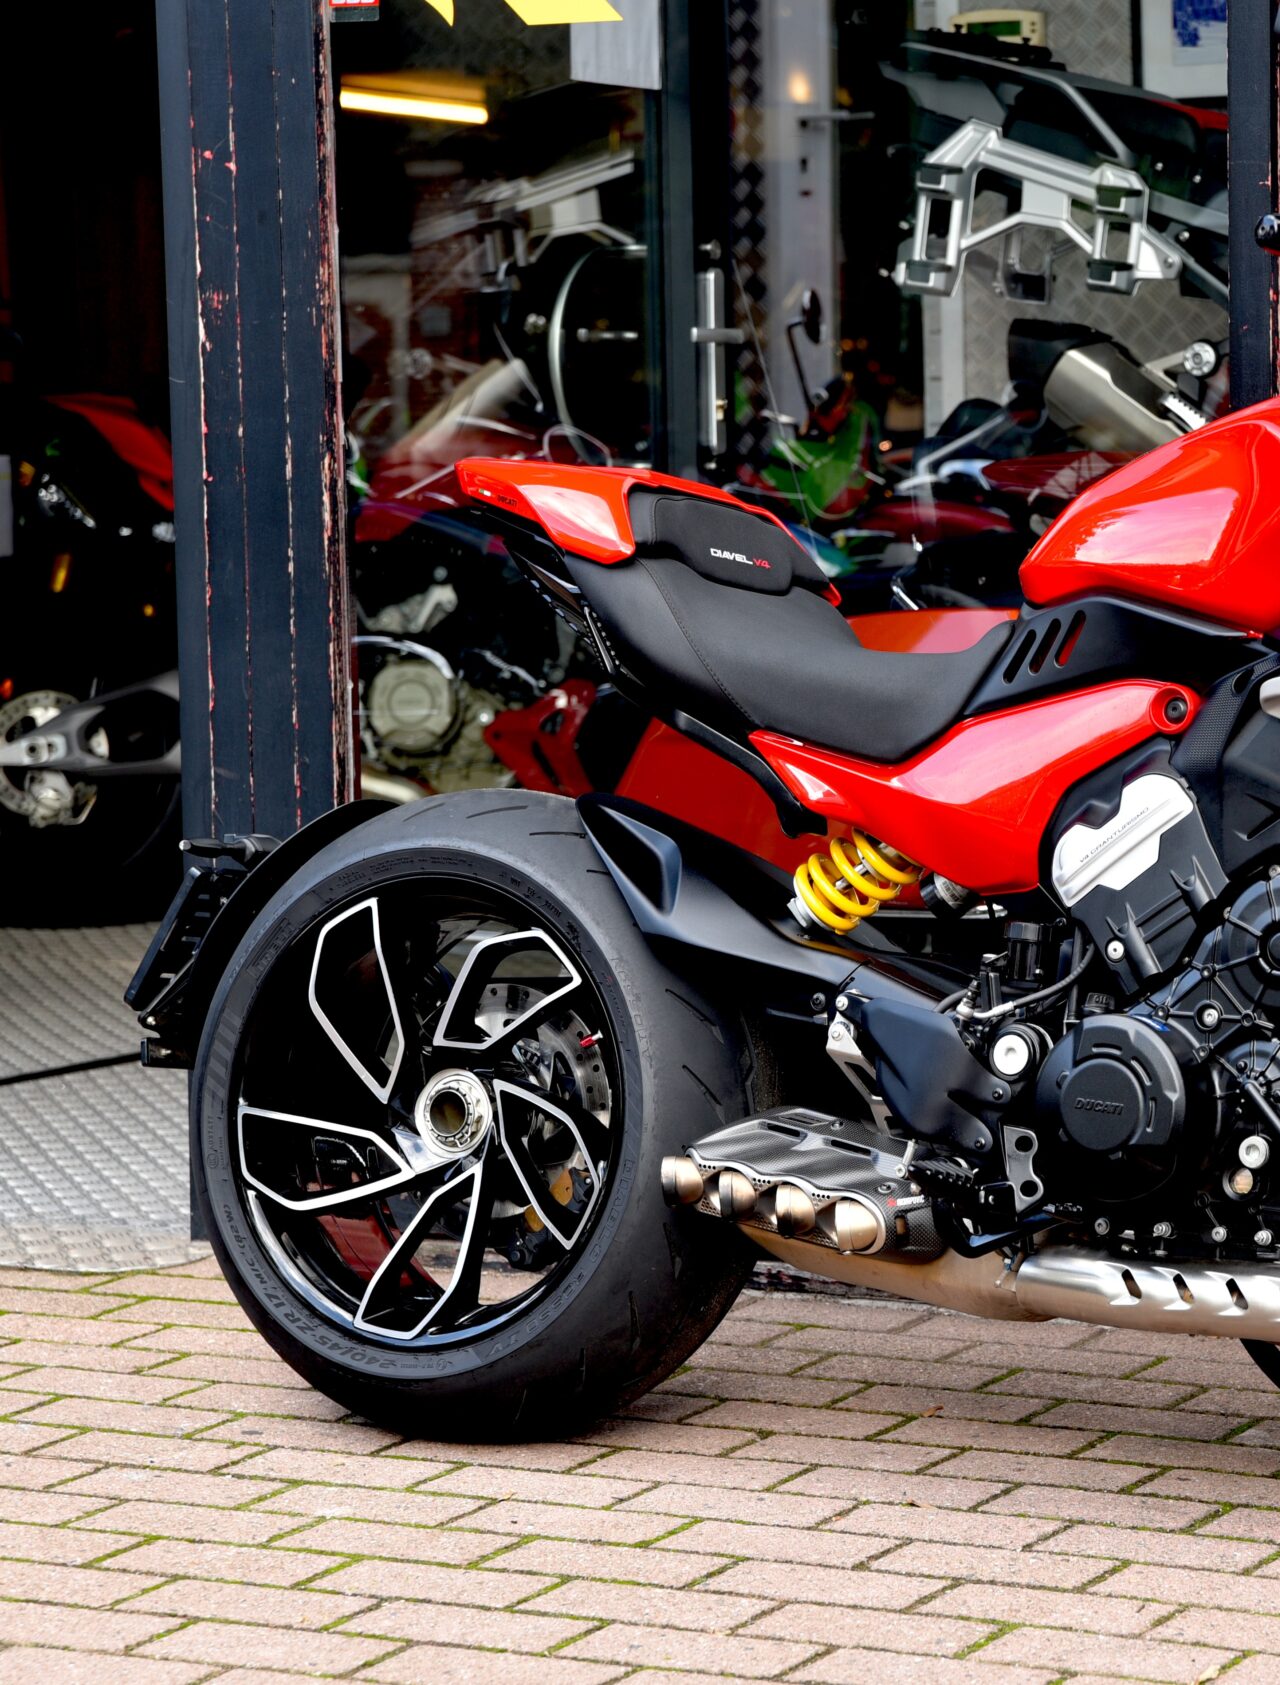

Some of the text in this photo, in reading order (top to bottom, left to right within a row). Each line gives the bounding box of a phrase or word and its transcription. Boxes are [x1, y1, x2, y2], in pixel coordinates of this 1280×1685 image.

[710, 547, 771, 569] DIAVEL V4
[1090, 807, 1149, 855] GRANTURISMO
[1075, 1097, 1124, 1116] DUCATI
